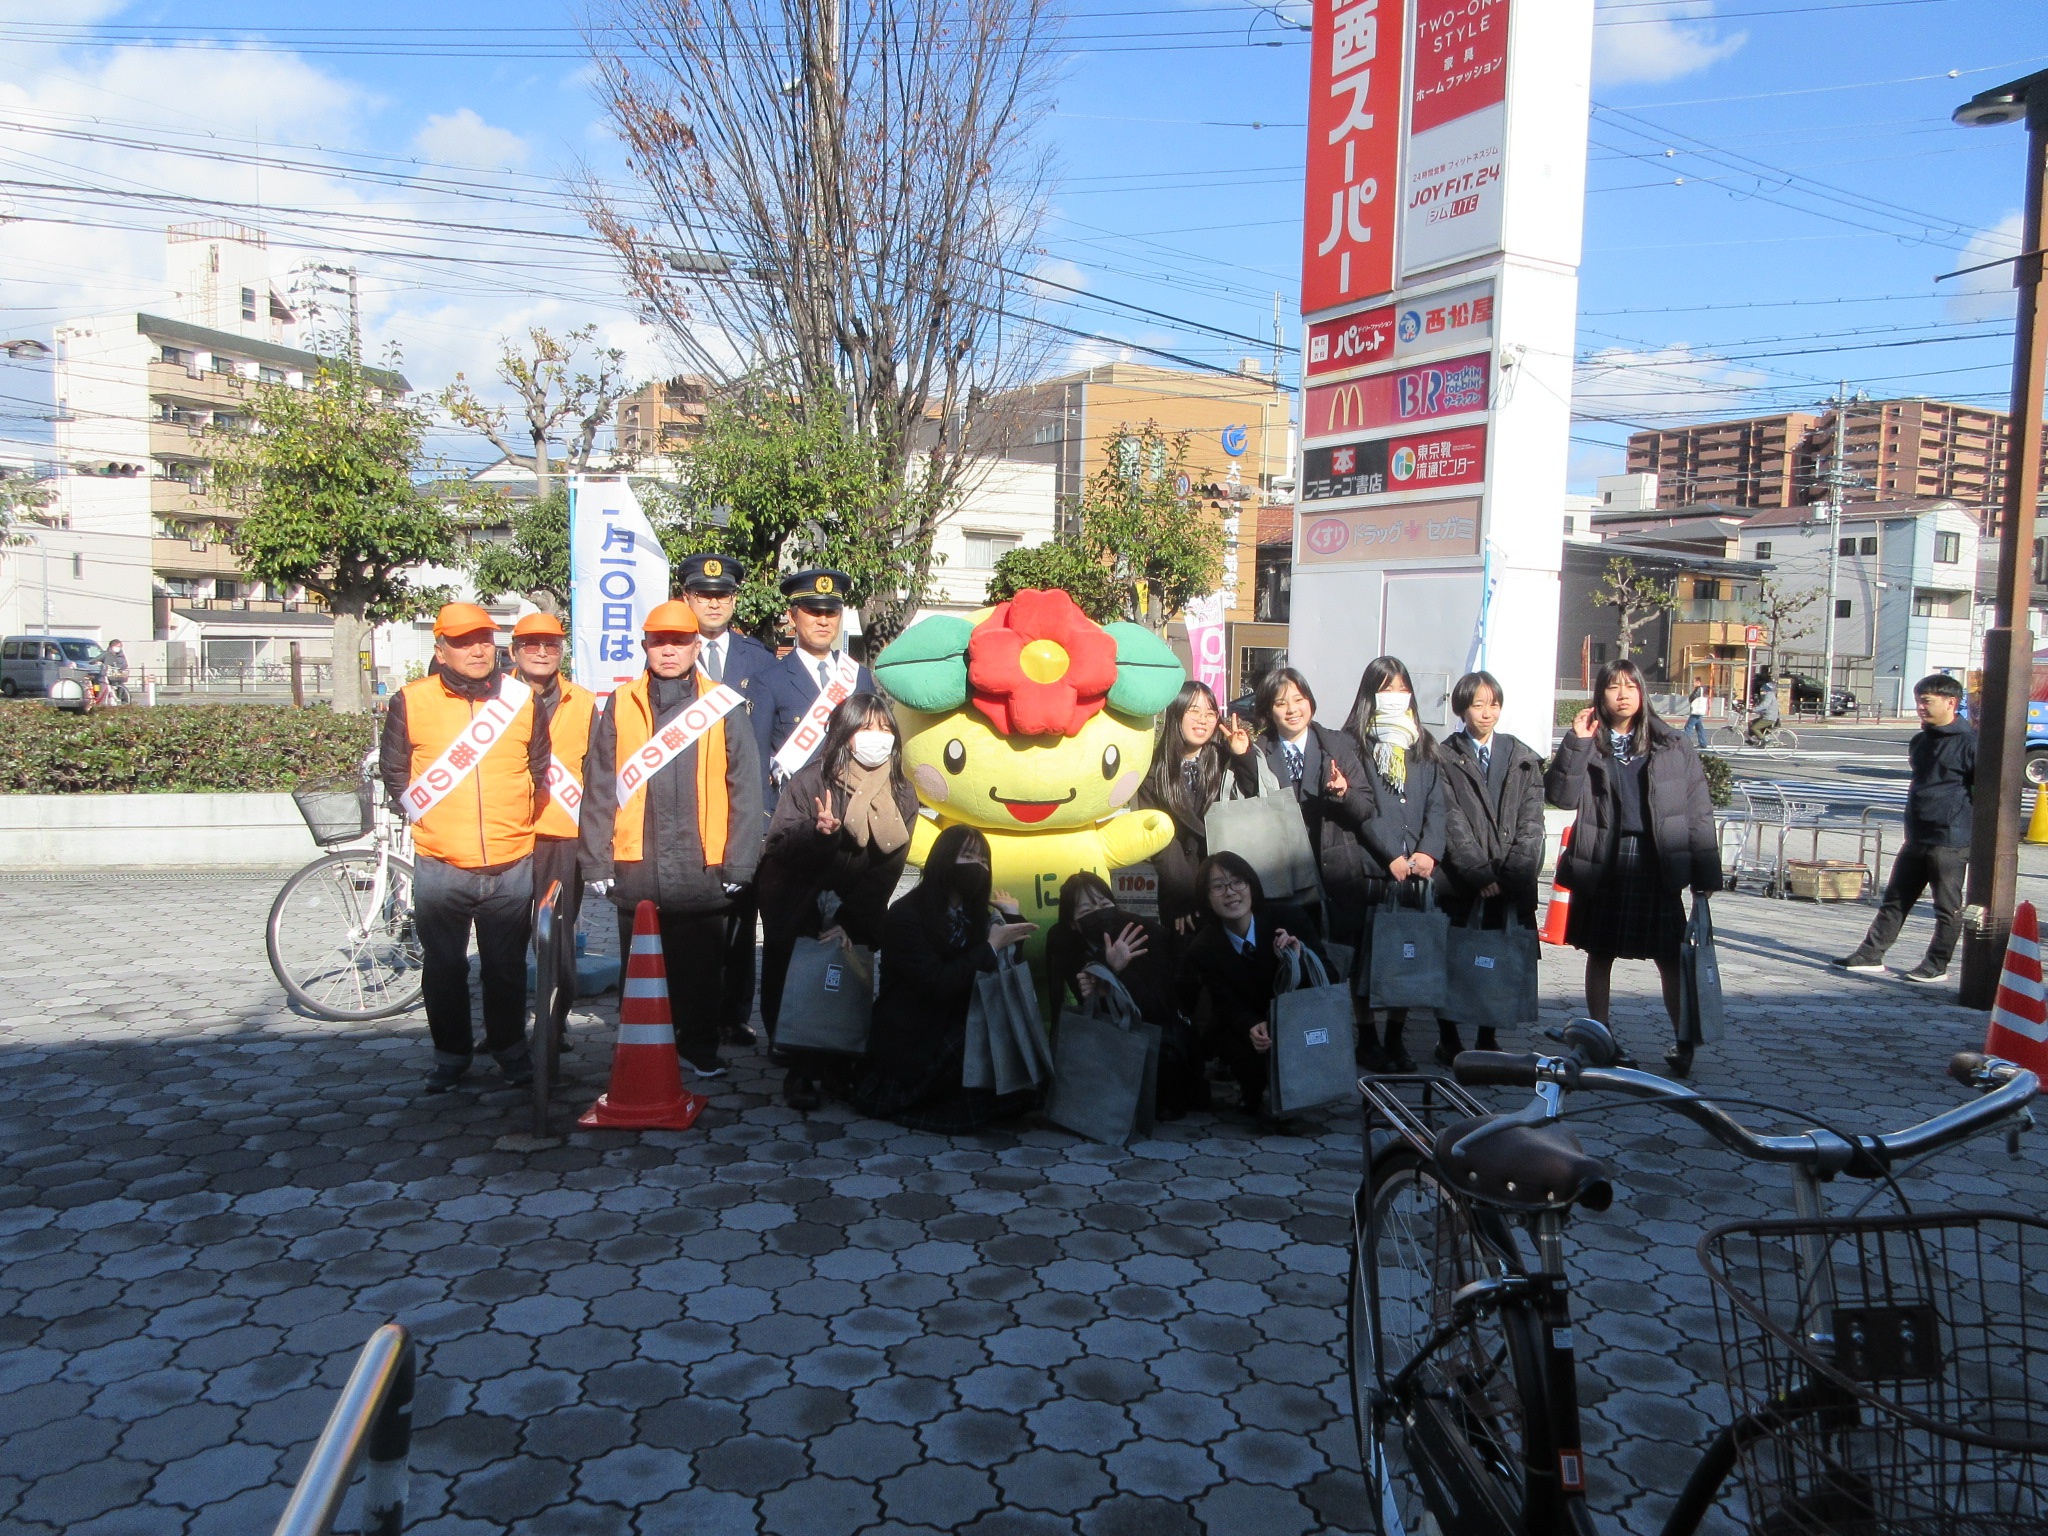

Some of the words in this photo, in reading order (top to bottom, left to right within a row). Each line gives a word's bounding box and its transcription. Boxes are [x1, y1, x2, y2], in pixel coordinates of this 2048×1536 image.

[1419, 0, 1504, 39] TWO-ON
[1433, 14, 1491, 53] STYLE
[1416, 56, 1503, 102] ホームファッション
[1319, 0, 1379, 294] 西スーパー
[1425, 295, 1494, 335] 西松屋
[1333, 325, 1386, 359] パレット
[1398, 369, 1443, 418] BR
[1333, 447, 1355, 474] 本
[1415, 457, 1476, 480] 流通センター
[1417, 441, 1452, 462] 東京靴
[1310, 525, 1346, 548] くすり
[1353, 520, 1404, 546] ドラッグ
[1426, 515, 1475, 542] セガミ
